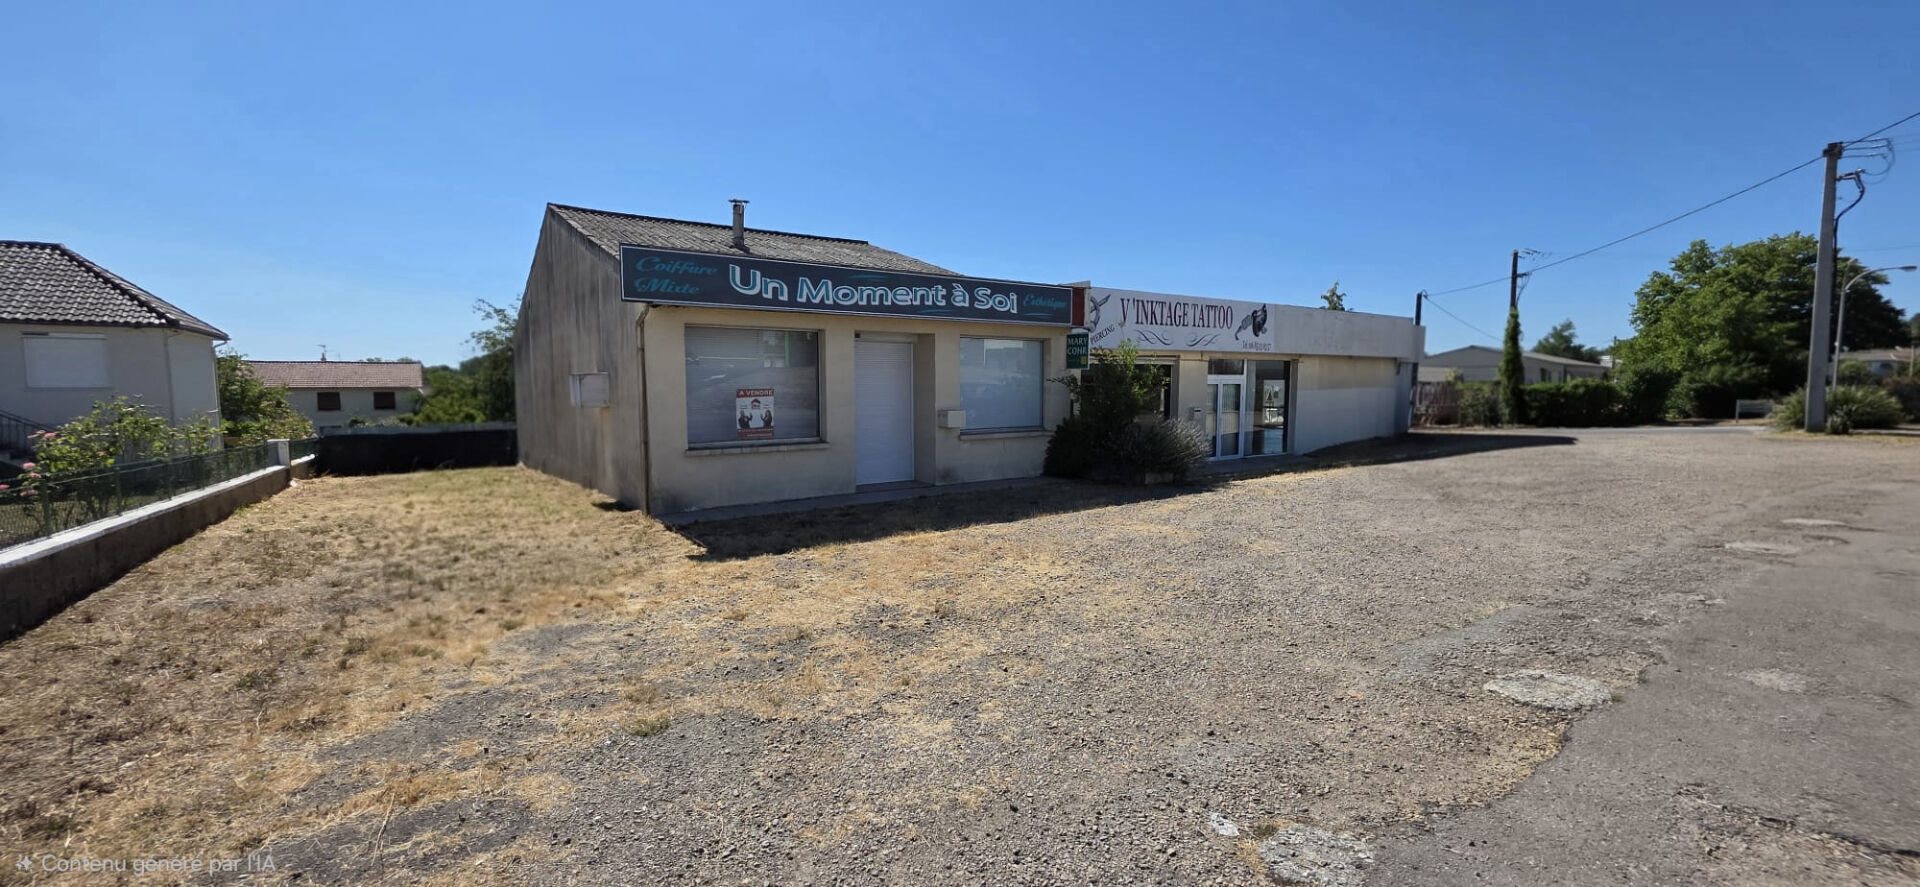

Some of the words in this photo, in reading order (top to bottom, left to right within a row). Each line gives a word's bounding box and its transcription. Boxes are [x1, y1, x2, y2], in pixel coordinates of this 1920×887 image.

[636, 256, 718, 275] Coiffure
[634, 277, 699, 294] Mixte
[729, 264, 788, 301] Un
[797, 276, 946, 306] Moment
[951, 283, 969, 307] à
[974, 287, 1017, 314] Soi
[1191, 303, 1233, 330] TATTOO
[1067, 337, 1088, 346] MARY
[1090, 324, 1115, 344] PIERCING
[746, 389, 774, 397] VENDRE
